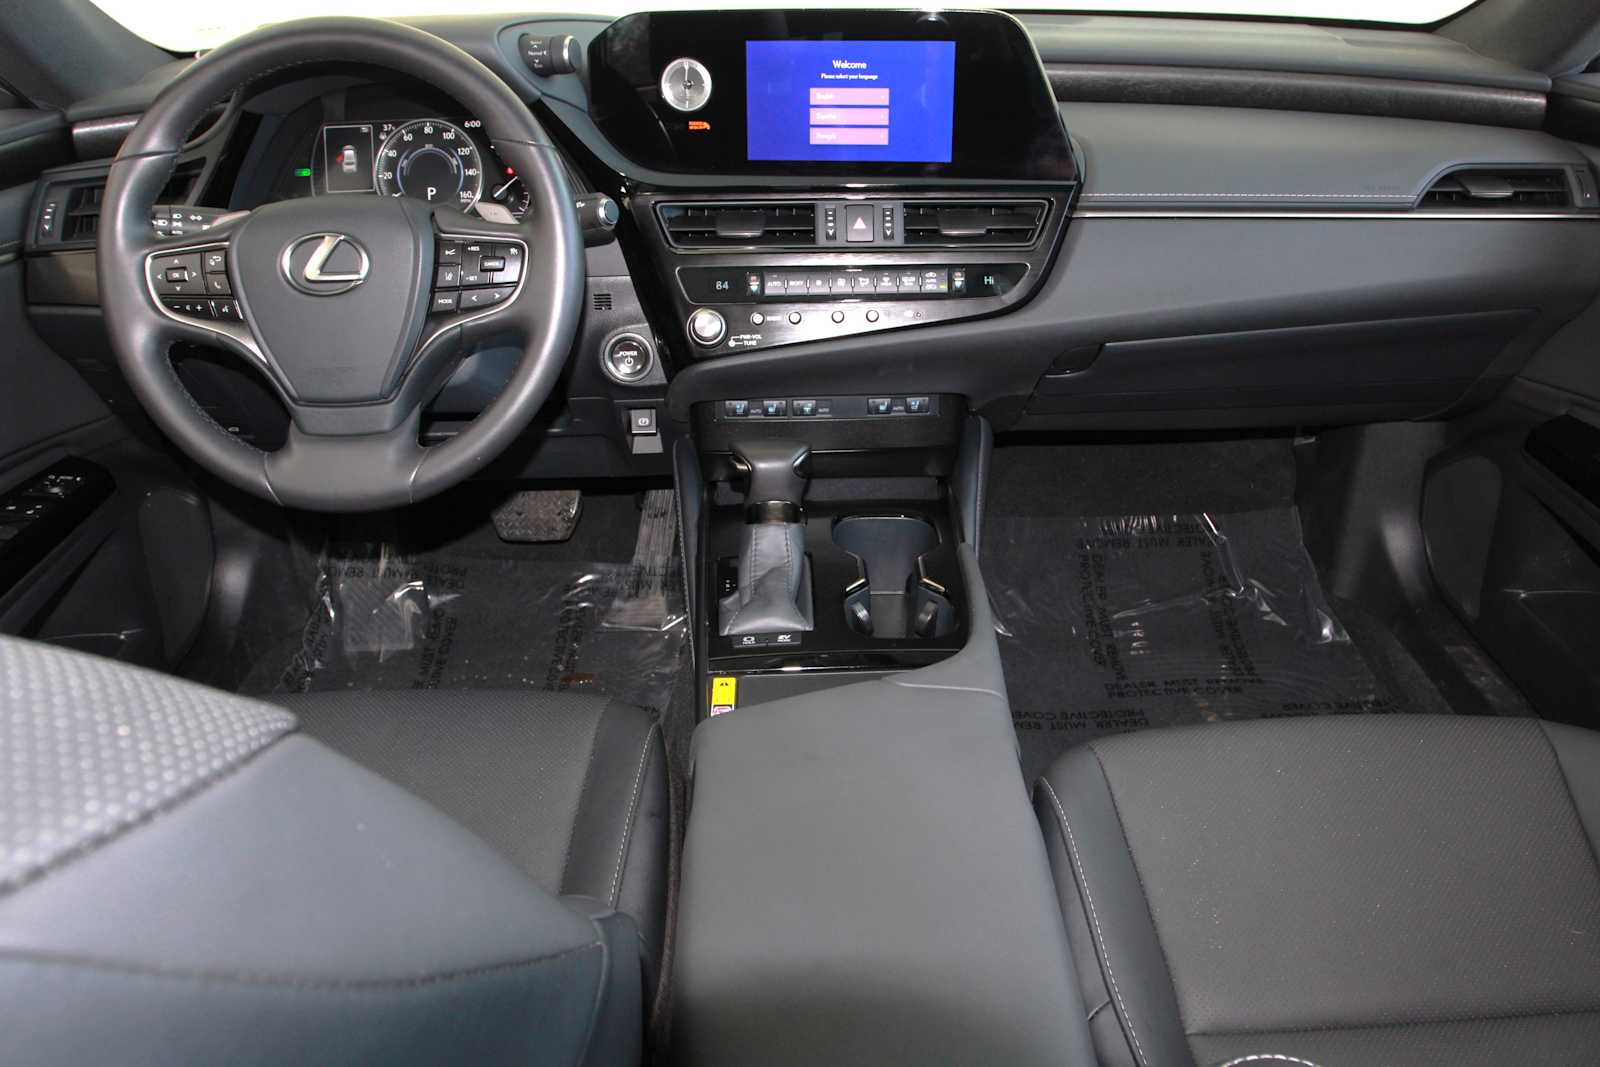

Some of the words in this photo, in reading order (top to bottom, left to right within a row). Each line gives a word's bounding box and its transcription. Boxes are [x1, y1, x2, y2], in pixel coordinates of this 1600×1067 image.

[832, 60, 867, 69] Welcome
[858, 73, 878, 81] language
[464, 120, 481, 128] 6:00
[424, 126, 433, 134] 80
[403, 134, 413, 142] 60
[442, 132, 455, 140] 100
[457, 147, 470, 155] 120
[383, 172, 393, 180] 20
[465, 168, 477, 176] 140
[427, 187, 437, 201] P
[459, 191, 472, 199] 160
[983, 275, 995, 286] Hi
[715, 281, 729, 290] 84
